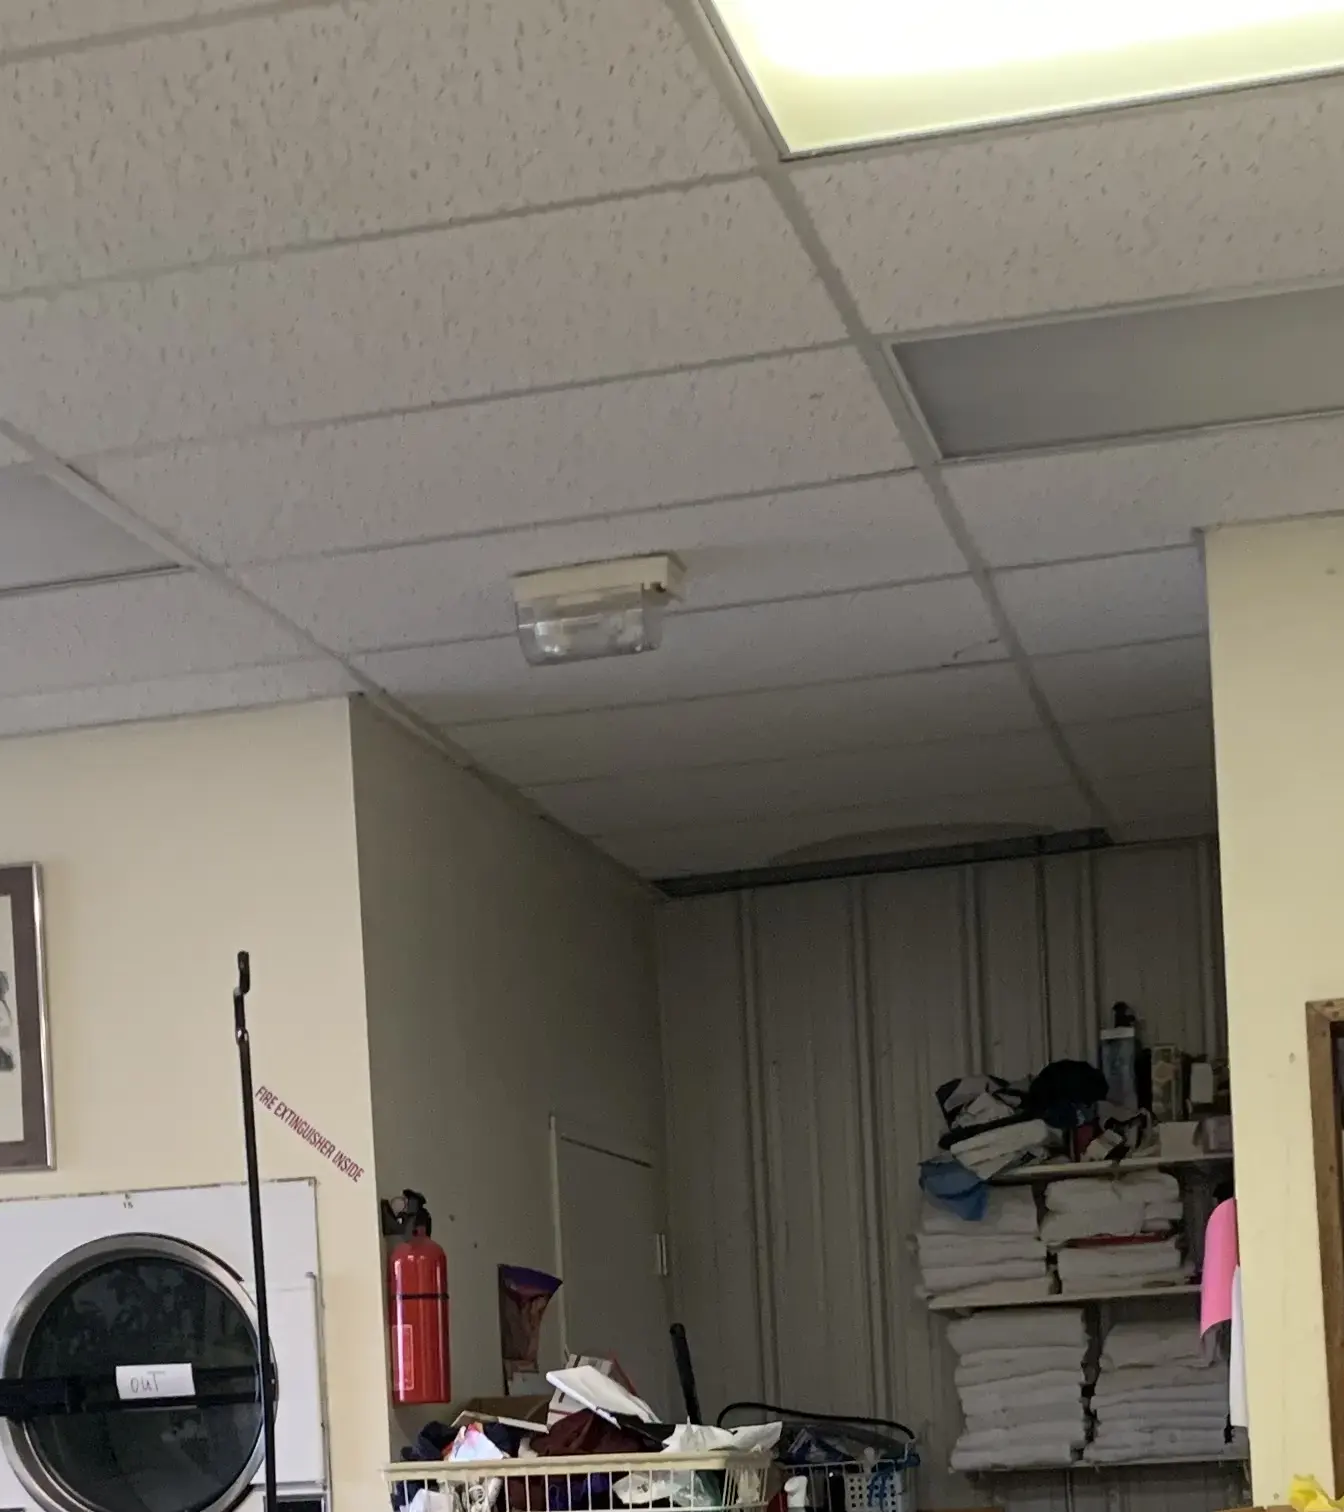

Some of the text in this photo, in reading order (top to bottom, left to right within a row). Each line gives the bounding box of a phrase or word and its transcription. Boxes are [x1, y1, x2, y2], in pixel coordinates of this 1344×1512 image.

[254, 1085, 365, 1183] FIRE EXTINGUISHER INSIDE
